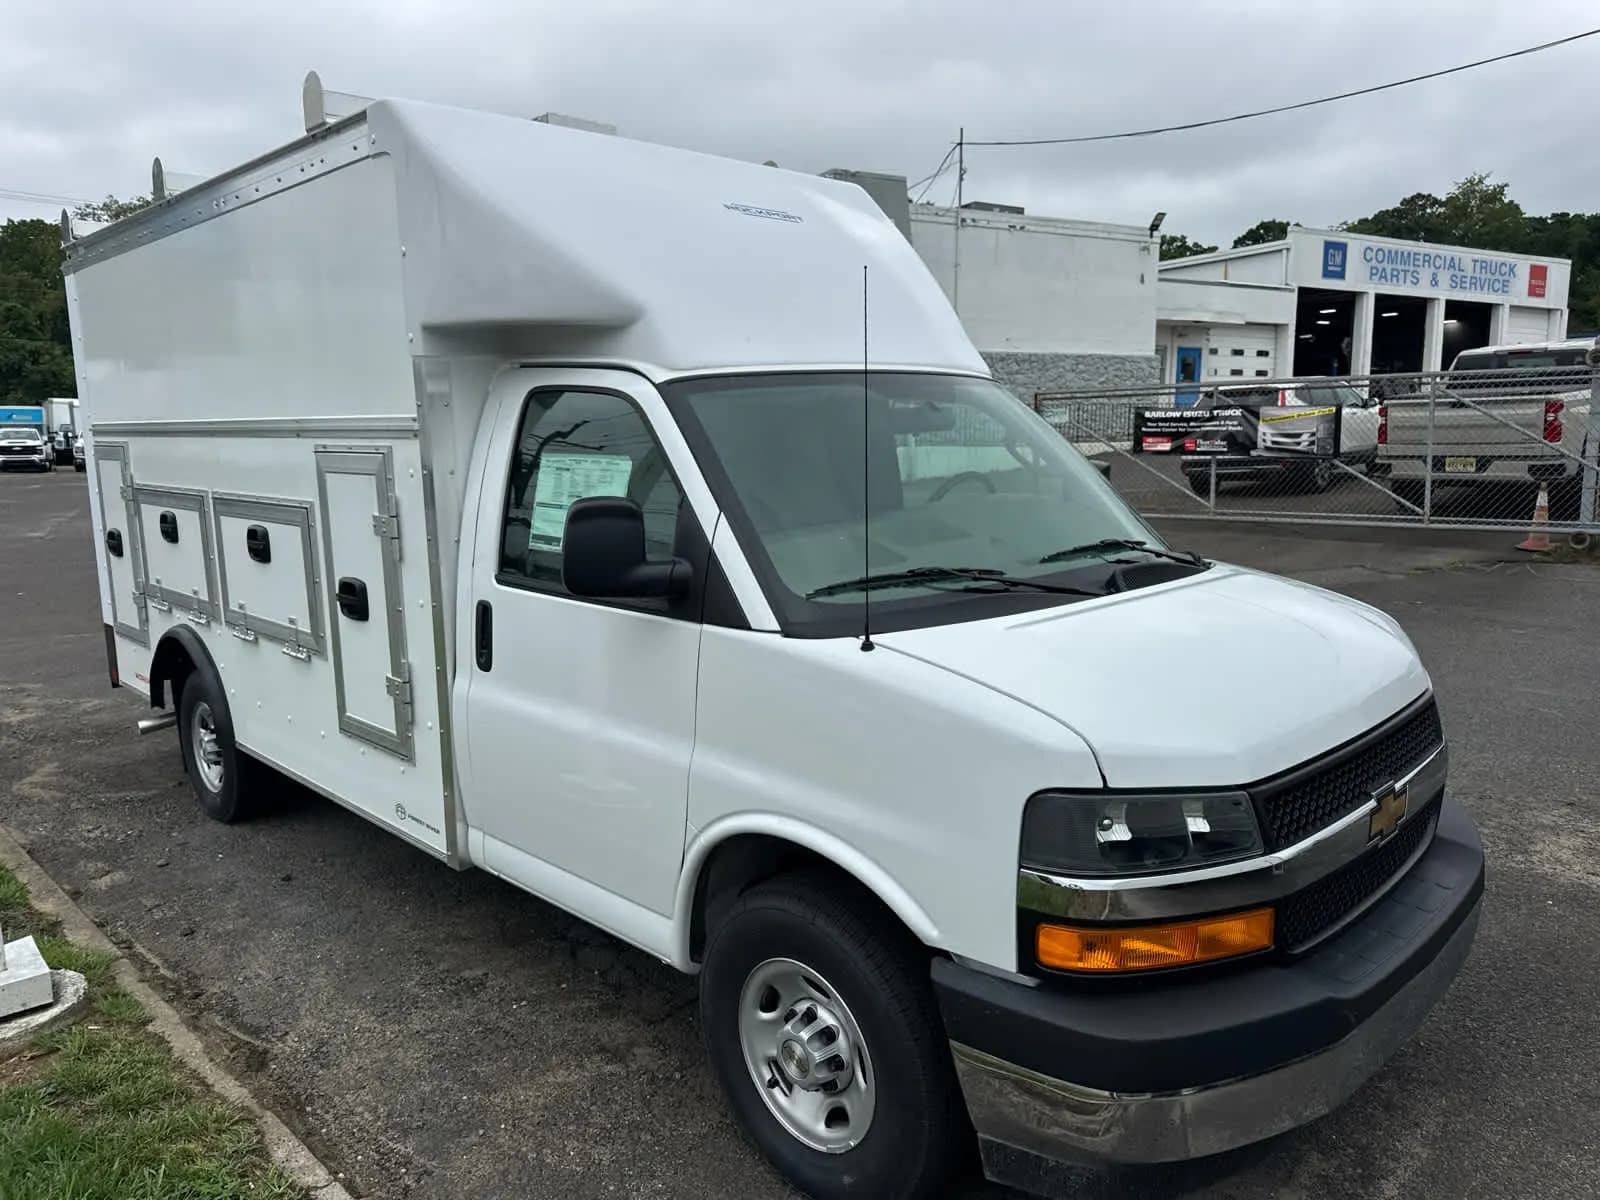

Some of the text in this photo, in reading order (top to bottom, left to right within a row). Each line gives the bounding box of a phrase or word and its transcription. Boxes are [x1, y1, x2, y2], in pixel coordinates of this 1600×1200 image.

[1327, 248, 1344, 266] GM
[1363, 246, 1518, 279] COMMERCIAL TRUCK
[1369, 266, 1511, 294] PARTS & SERVICE
[1144, 408, 1243, 418] BARLOW ISUZU TRUCK
